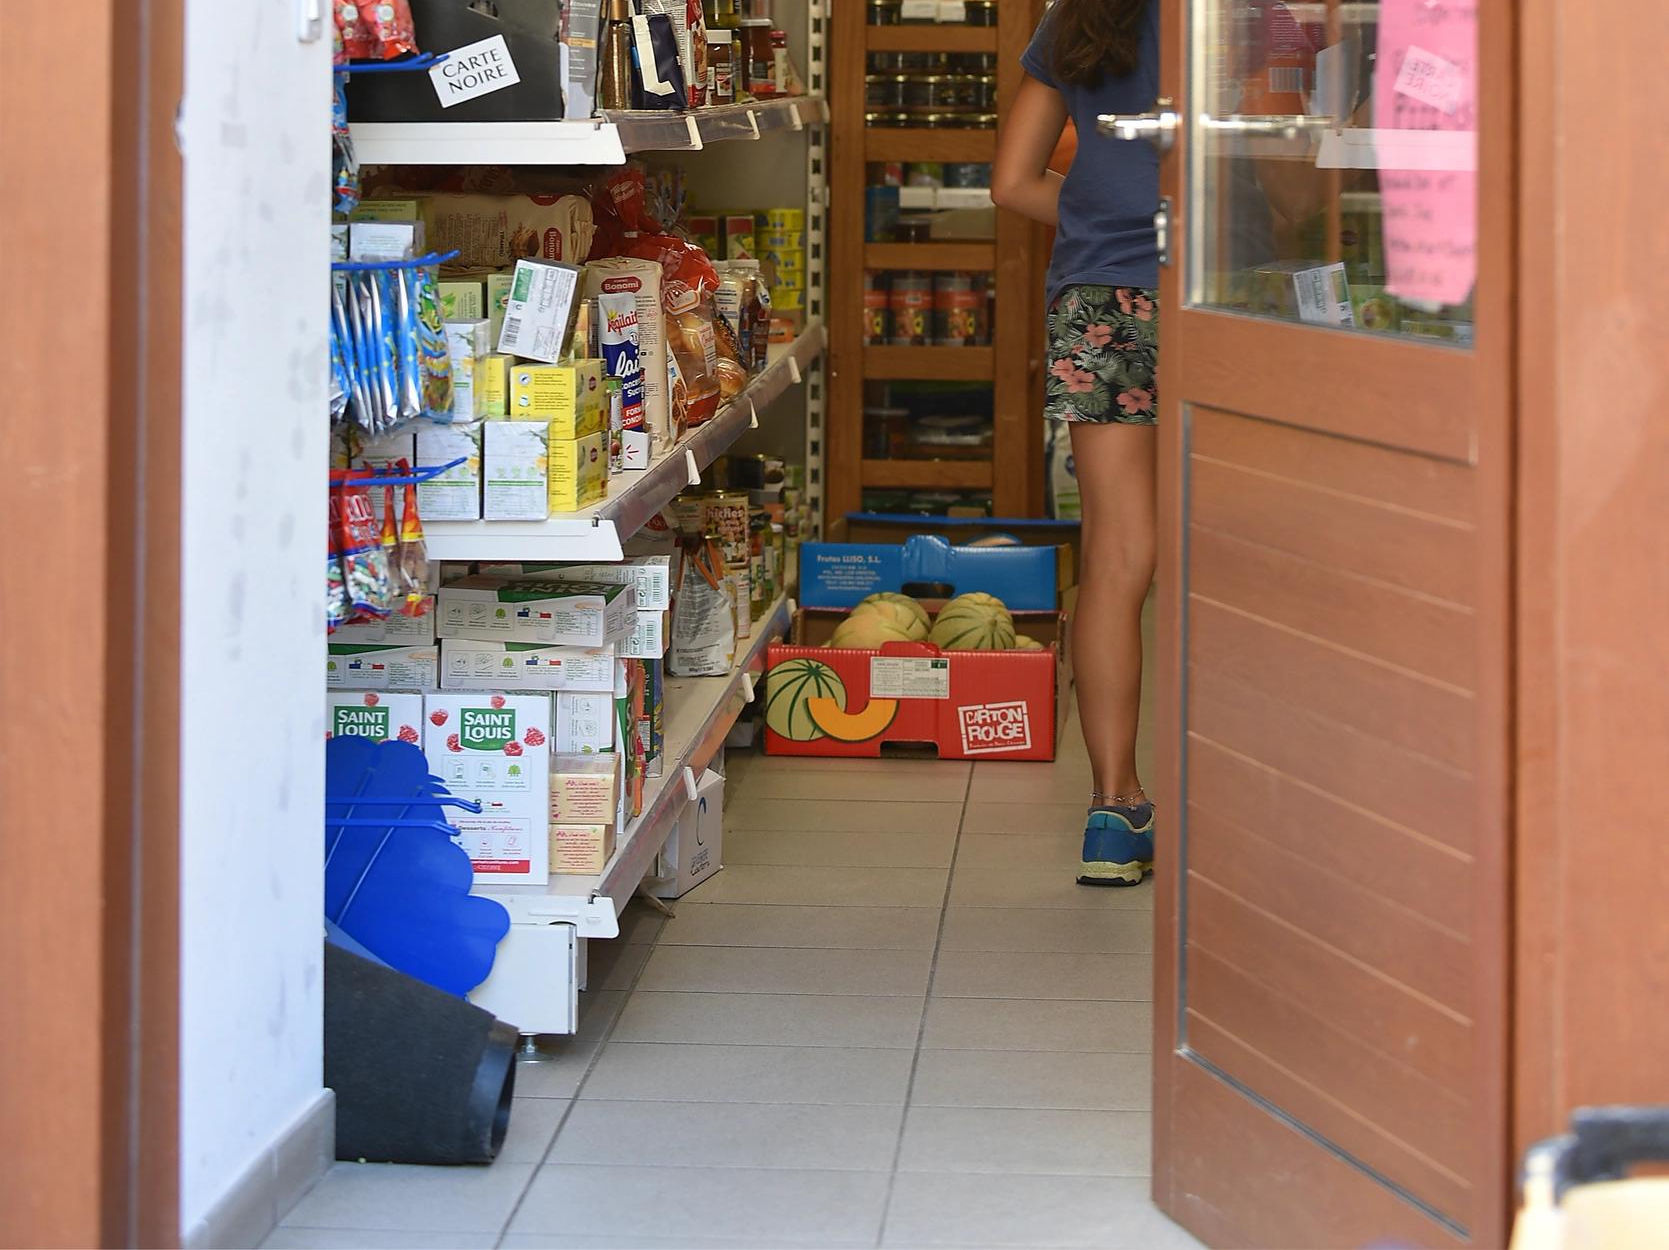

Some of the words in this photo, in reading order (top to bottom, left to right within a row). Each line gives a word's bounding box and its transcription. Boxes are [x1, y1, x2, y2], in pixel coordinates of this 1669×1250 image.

[442, 48, 502, 78] CARTE
[448, 64, 508, 94] NOIRE
[549, 231, 558, 259] Bonom
[604, 282, 639, 291] Bonomi
[615, 349, 640, 378] lai
[338, 710, 386, 723] SAINT
[464, 711, 513, 726] SAINT
[965, 708, 1023, 725] CARTON
[464, 725, 512, 742] LOUIS
[967, 722, 1024, 742] ROUGE
